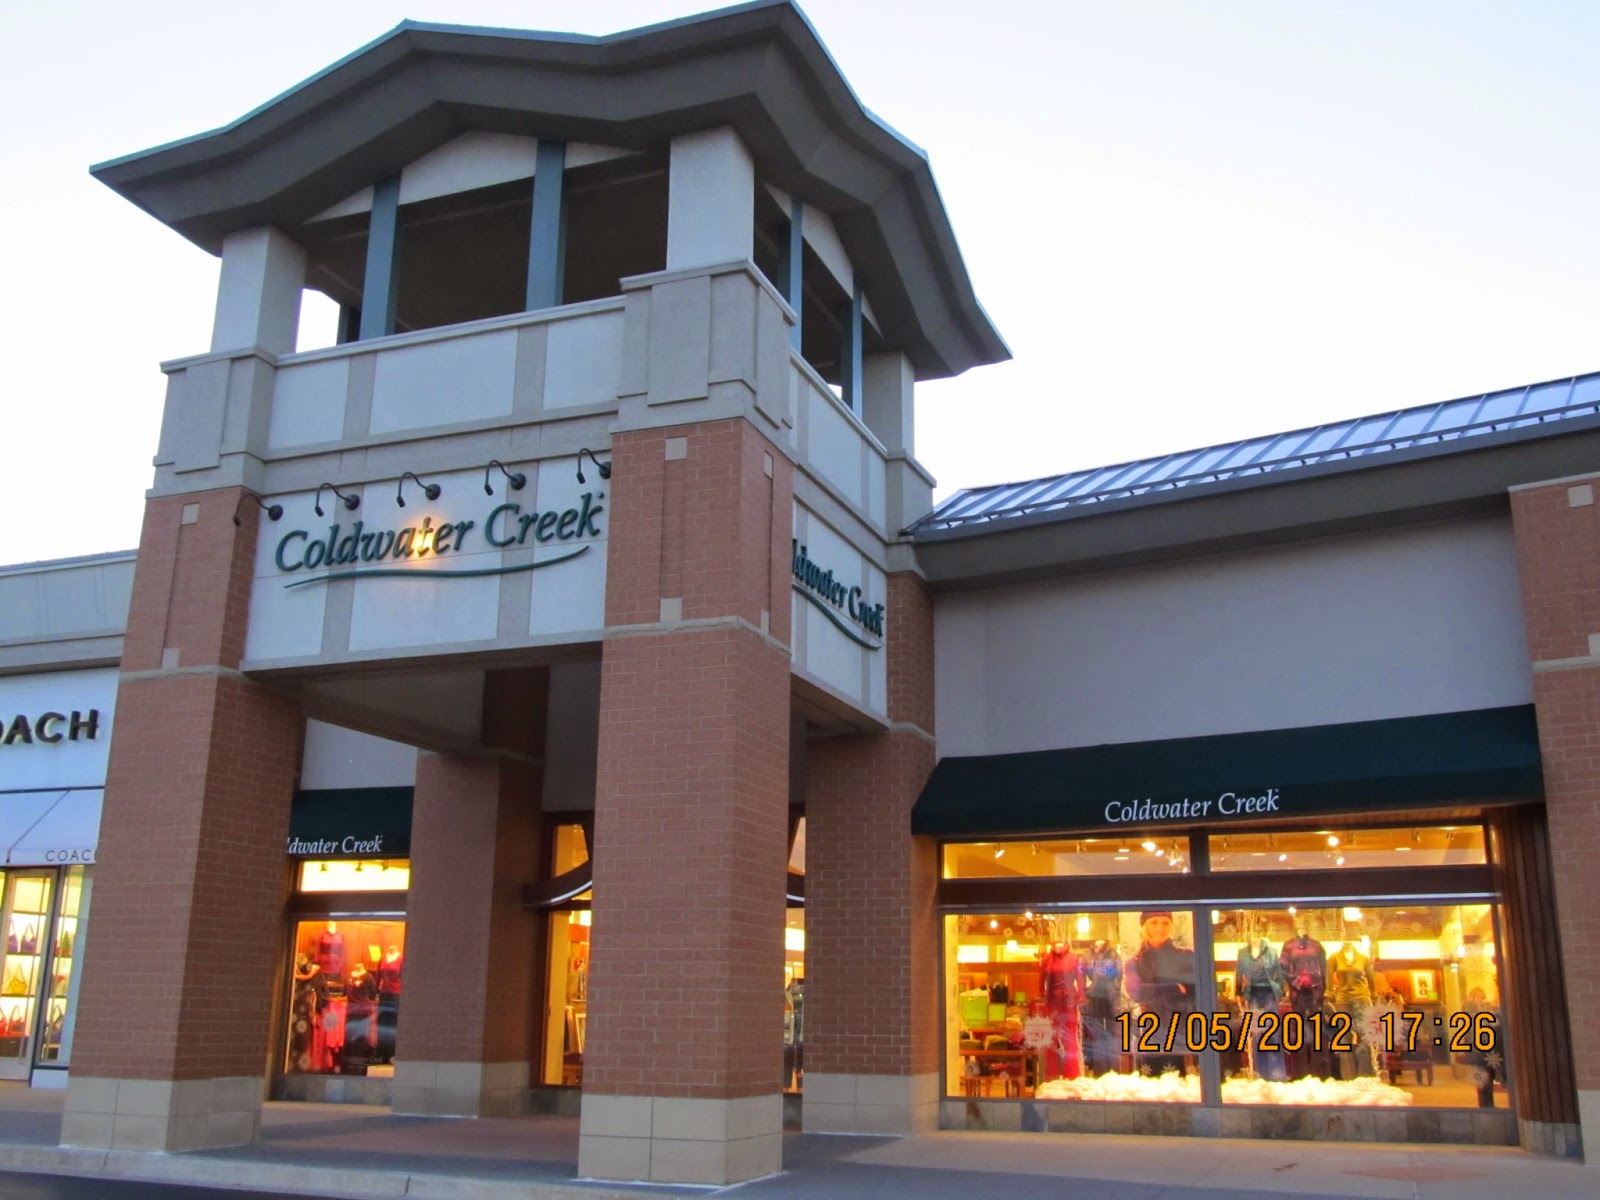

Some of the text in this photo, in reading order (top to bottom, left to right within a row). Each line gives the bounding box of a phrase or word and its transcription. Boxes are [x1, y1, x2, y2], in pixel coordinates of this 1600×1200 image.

[274, 491, 605, 573] Coldwater Creek
[0, 709, 99, 745] ACH
[1104, 788, 1280, 823] Coldwater Creek
[45, 849, 96, 863] COAC
[287, 834, 383, 855] dwater Creek
